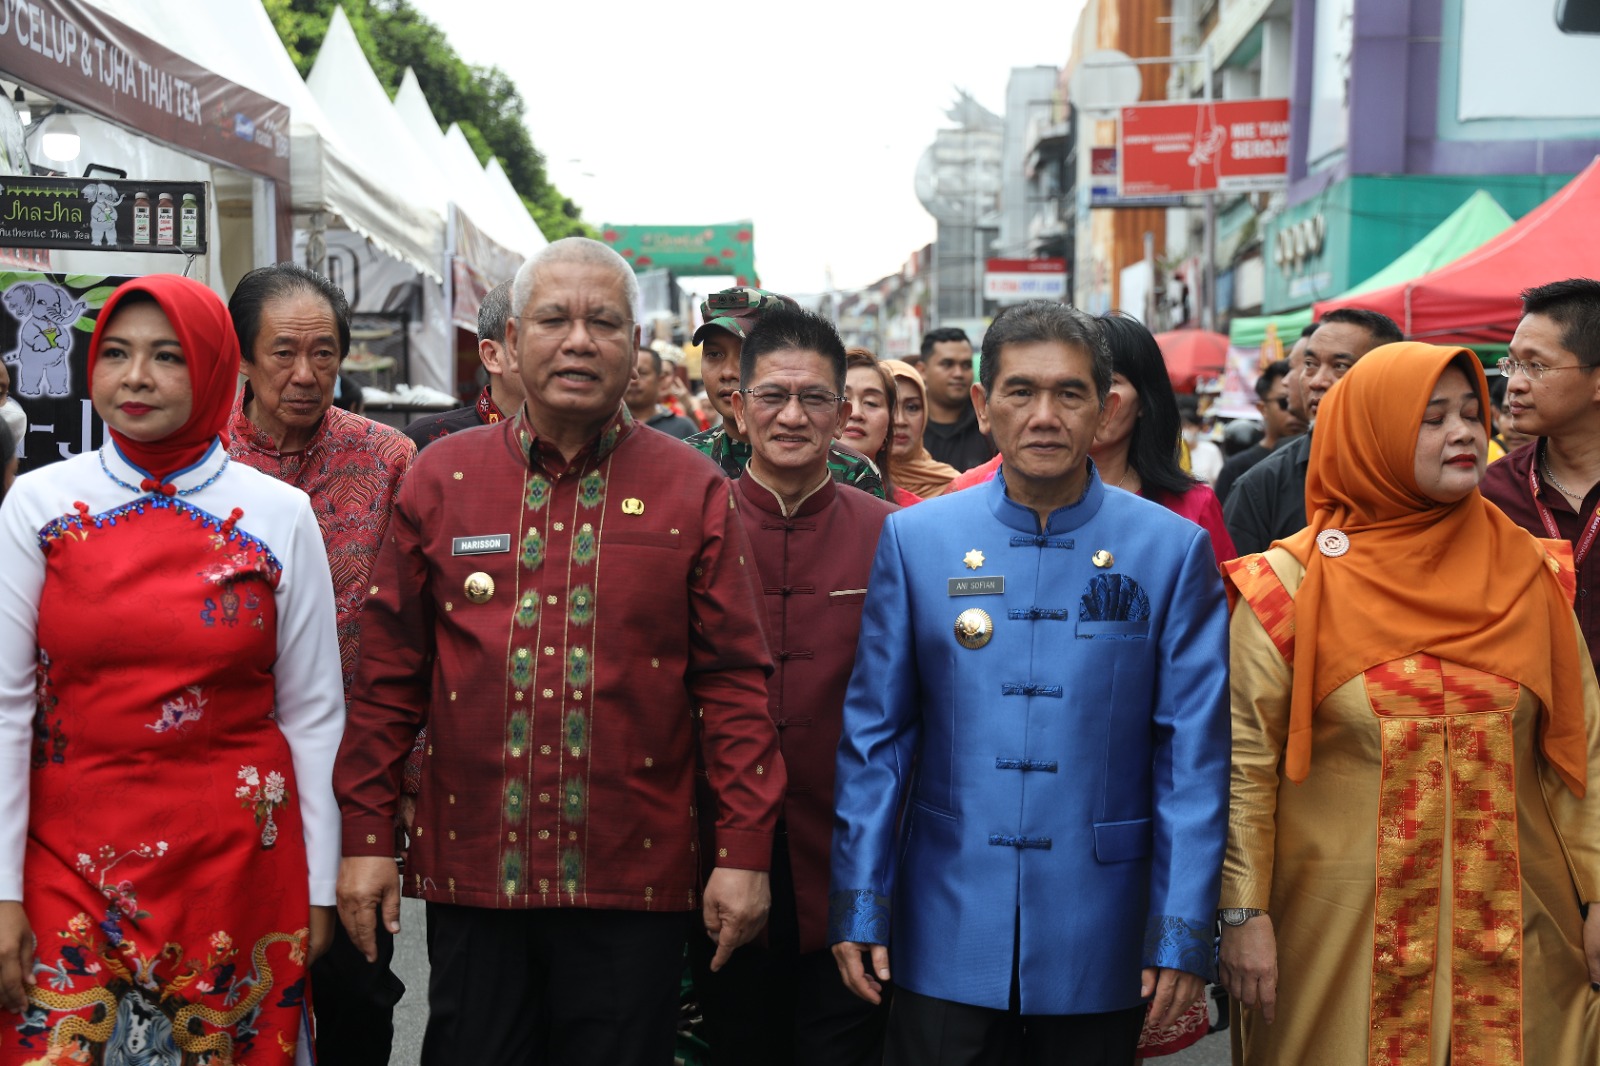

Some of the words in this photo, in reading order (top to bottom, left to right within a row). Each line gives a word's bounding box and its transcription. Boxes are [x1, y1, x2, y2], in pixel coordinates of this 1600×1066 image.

[81, 31, 92, 78] &
[95, 37, 137, 98] TJHA
[138, 60, 172, 113] THAI
[174, 77, 202, 126] TEA
[50, 229, 70, 239] Thai
[74, 230, 90, 240] Tea
[461, 539, 501, 550] HARISSON
[956, 582, 969, 590] ANI
[970, 581, 995, 590] SOFIAN
